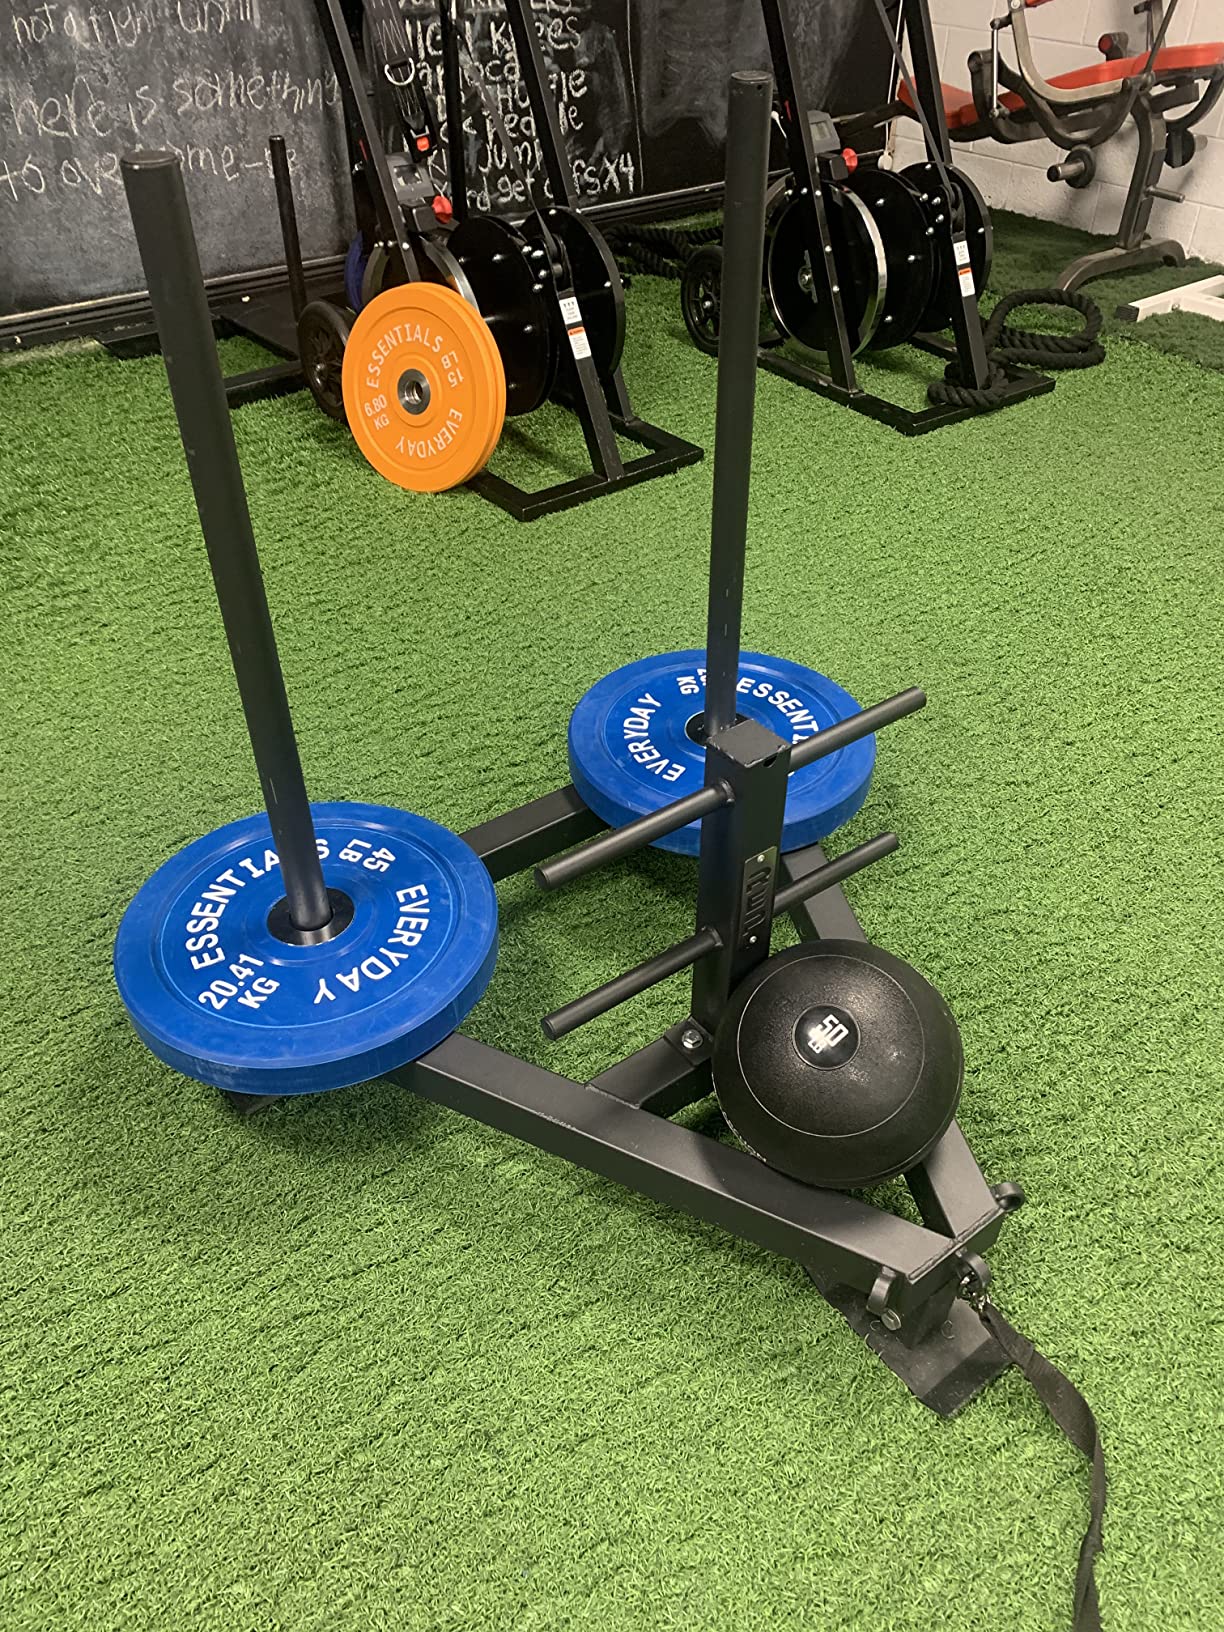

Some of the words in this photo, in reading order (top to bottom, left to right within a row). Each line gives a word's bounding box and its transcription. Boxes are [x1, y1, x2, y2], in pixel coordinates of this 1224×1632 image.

[366, 323, 443, 389] ESSENTIALS
[440, 350, 459, 370] LB
[447, 371, 465, 388] 15
[363, 394, 388, 417] 6.80
[373, 414, 390, 430] KG
[395, 407, 463, 459] EVERYDAY
[676, 676, 700, 696] KG
[736, 677, 819, 745] ESSENT
[623, 692, 686, 782] EVERYDAY
[338, 837, 373, 863] LB
[362, 846, 397, 875] 45
[184, 837, 330, 970] ESSENTIAS
[313, 883, 430, 1005] EVERYDAY
[198, 953, 265, 1010] 20.41
[237, 976, 281, 1010] KG
[821, 1013, 849, 1048] 50
